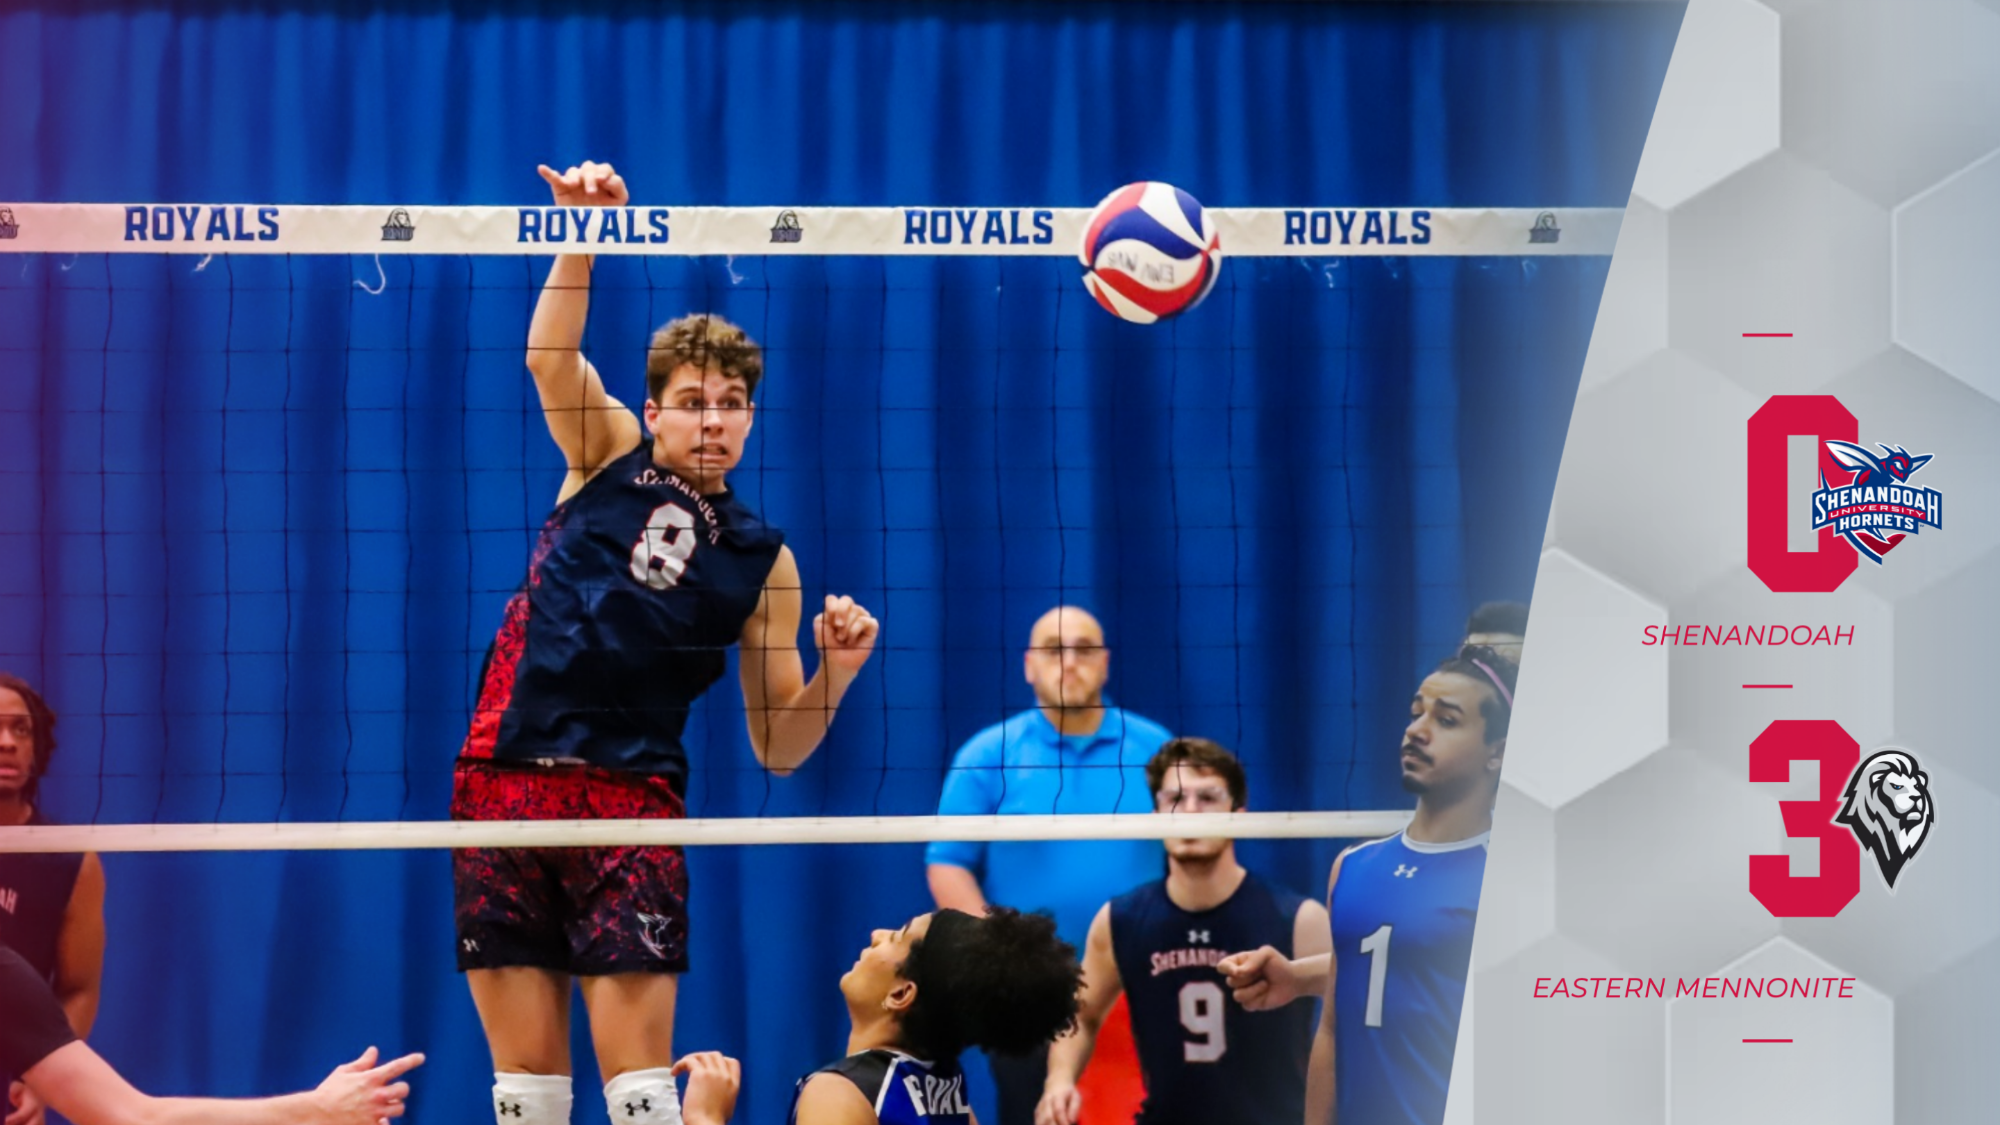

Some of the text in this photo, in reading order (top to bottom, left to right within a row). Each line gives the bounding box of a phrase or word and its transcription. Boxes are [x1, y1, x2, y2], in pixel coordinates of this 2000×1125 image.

[124, 206, 280, 241] ROYALS
[517, 208, 670, 244] ROYALS
[904, 210, 1054, 245] ROYALS
[1283, 210, 1432, 246] ROYALS
[630, 501, 697, 590] 8
[1360, 924, 1392, 1028] 1
[1178, 981, 1227, 1062] 9
